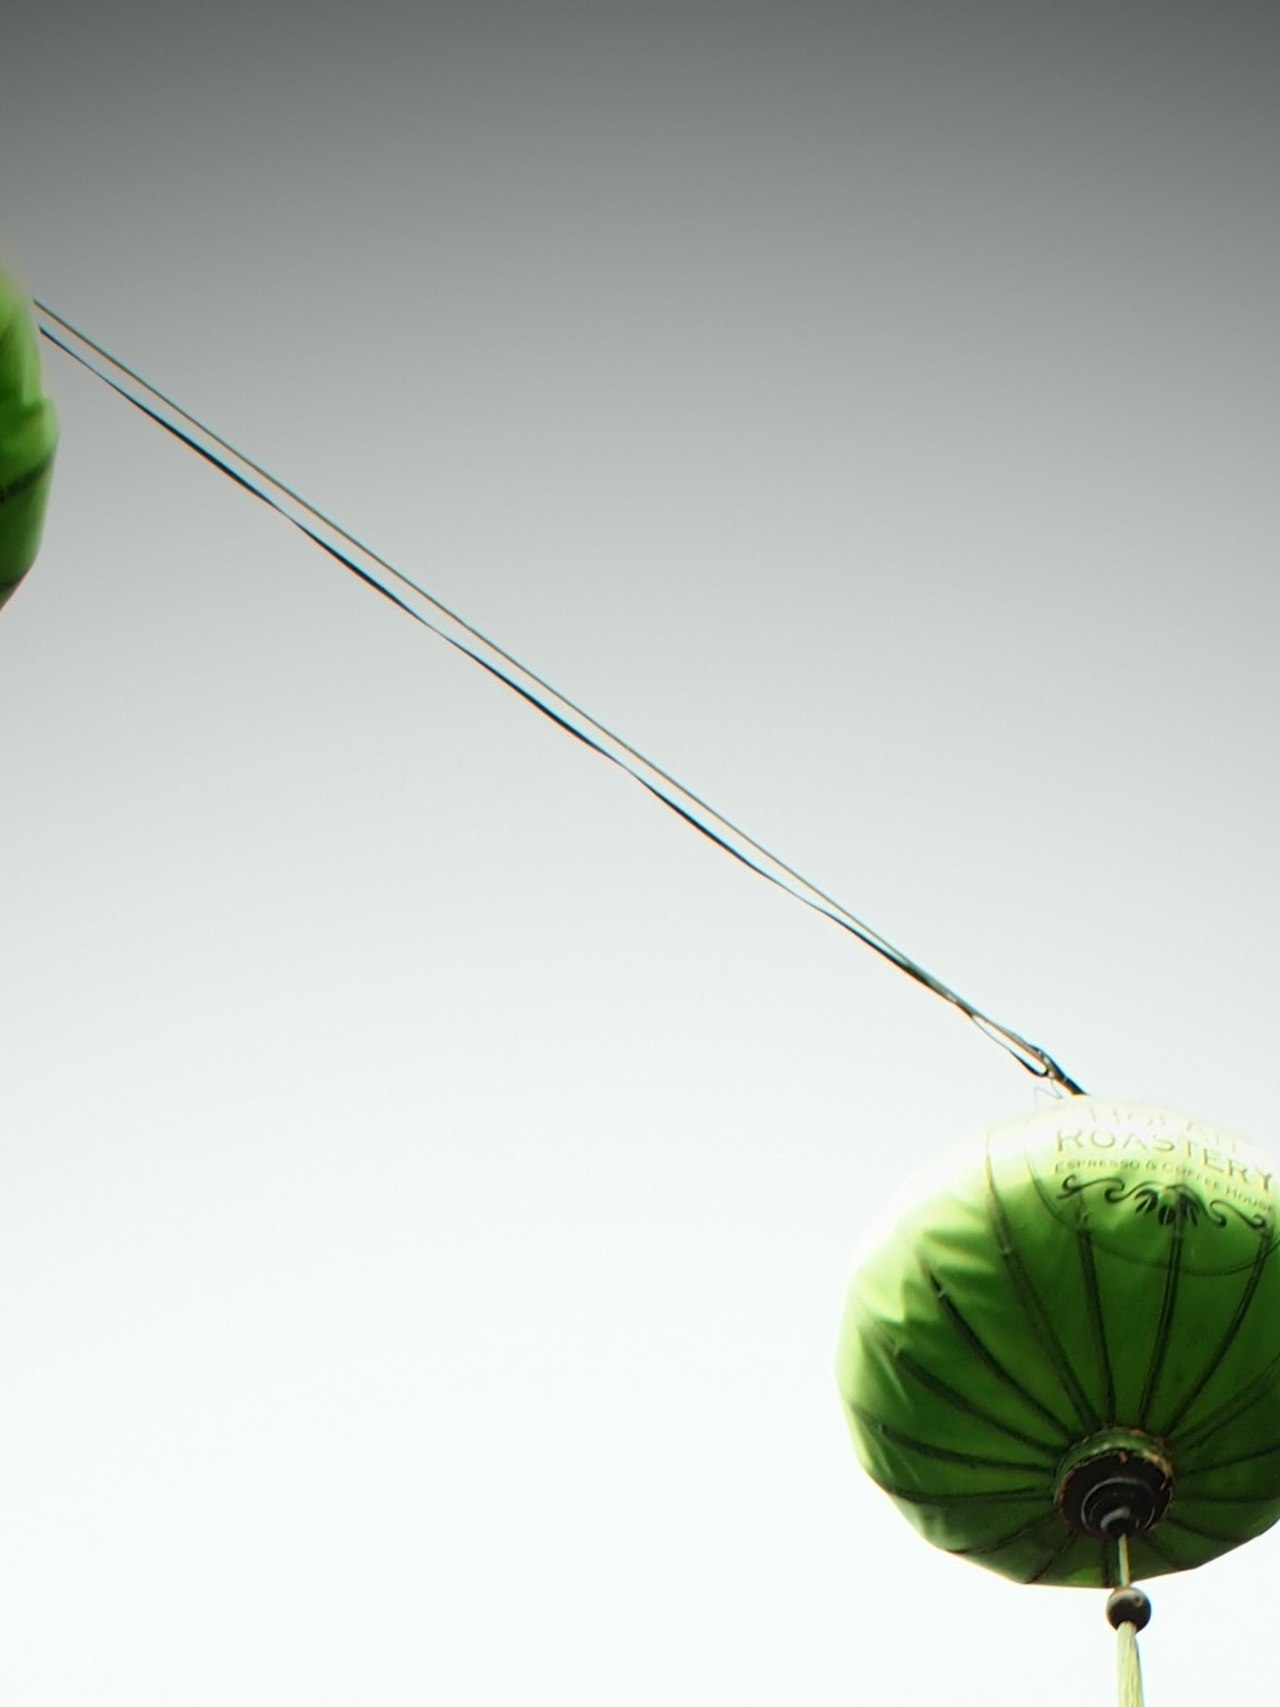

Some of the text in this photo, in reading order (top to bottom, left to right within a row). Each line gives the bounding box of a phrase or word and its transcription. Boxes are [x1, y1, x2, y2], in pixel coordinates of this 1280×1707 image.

[1055, 1159, 1140, 1175] ESPRESSO
[1162, 1160, 1220, 1189] COFFEE
[1224, 1184, 1273, 1211] HOUSE
[1056, 1128, 1273, 1191] ROASTERY
